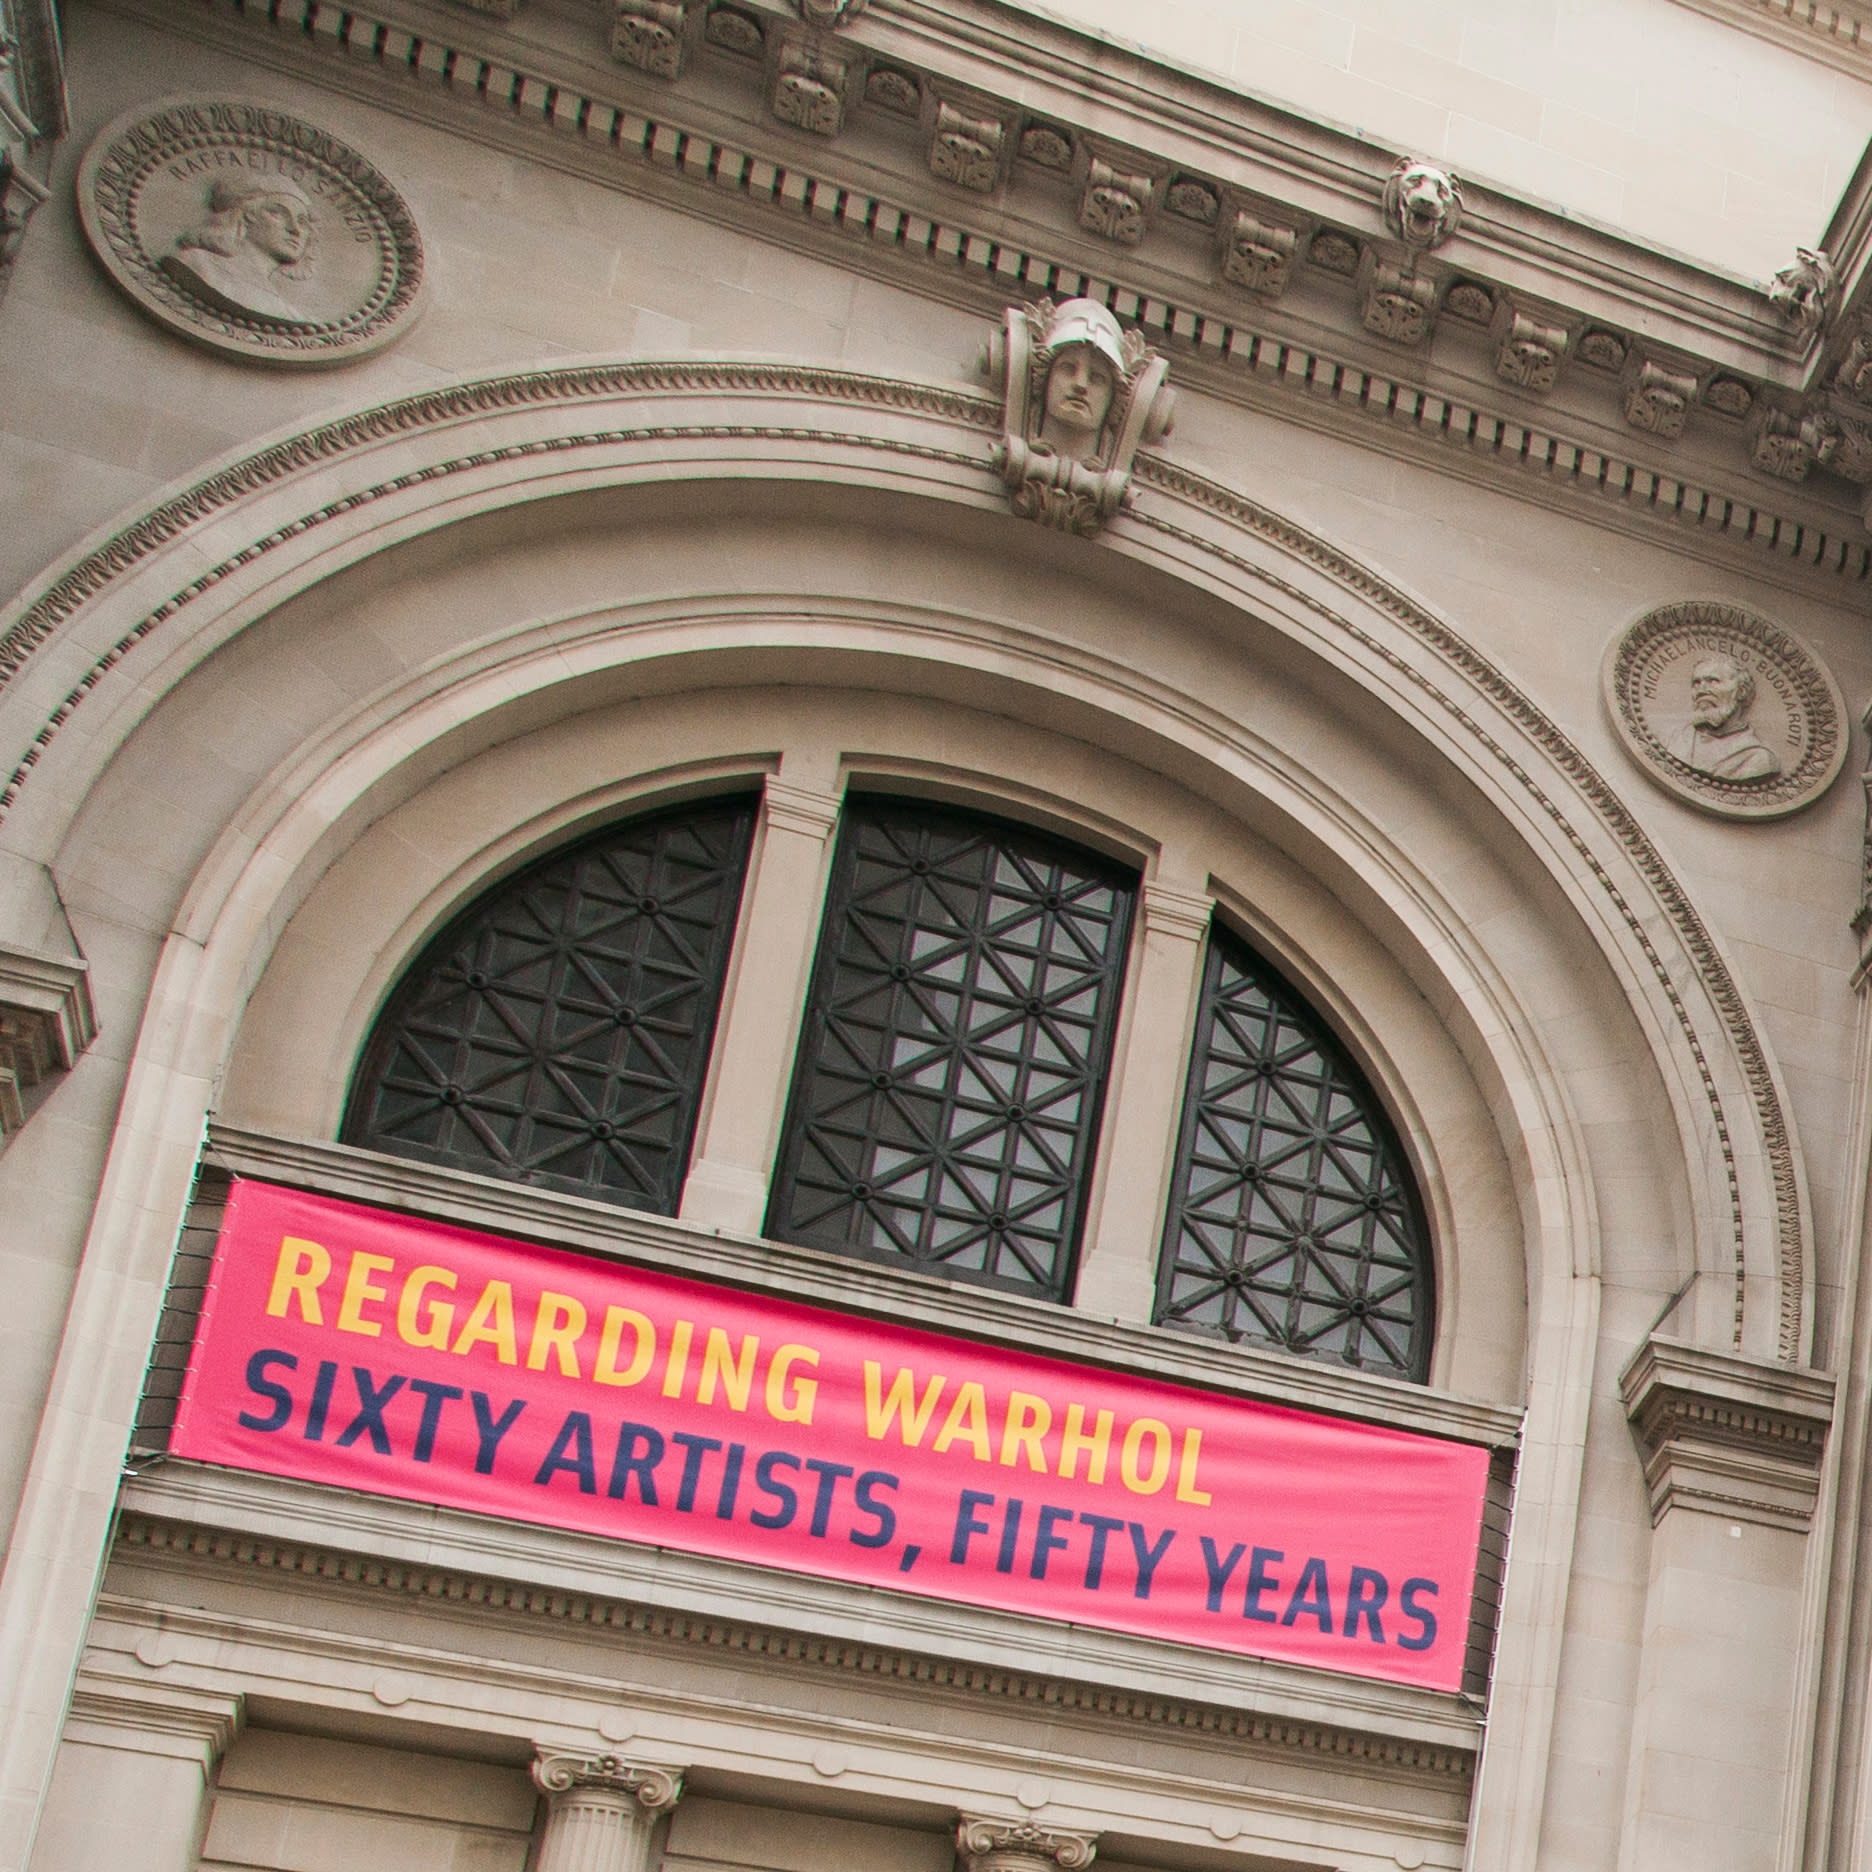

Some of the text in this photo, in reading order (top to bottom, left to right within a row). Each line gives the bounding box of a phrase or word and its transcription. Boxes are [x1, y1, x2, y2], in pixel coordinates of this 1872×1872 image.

[238, 1349, 1440, 1651] SIXTY ARTISTS, FIFTY YEARS
[266, 1235, 1212, 1507] REGARDING WARHOL
